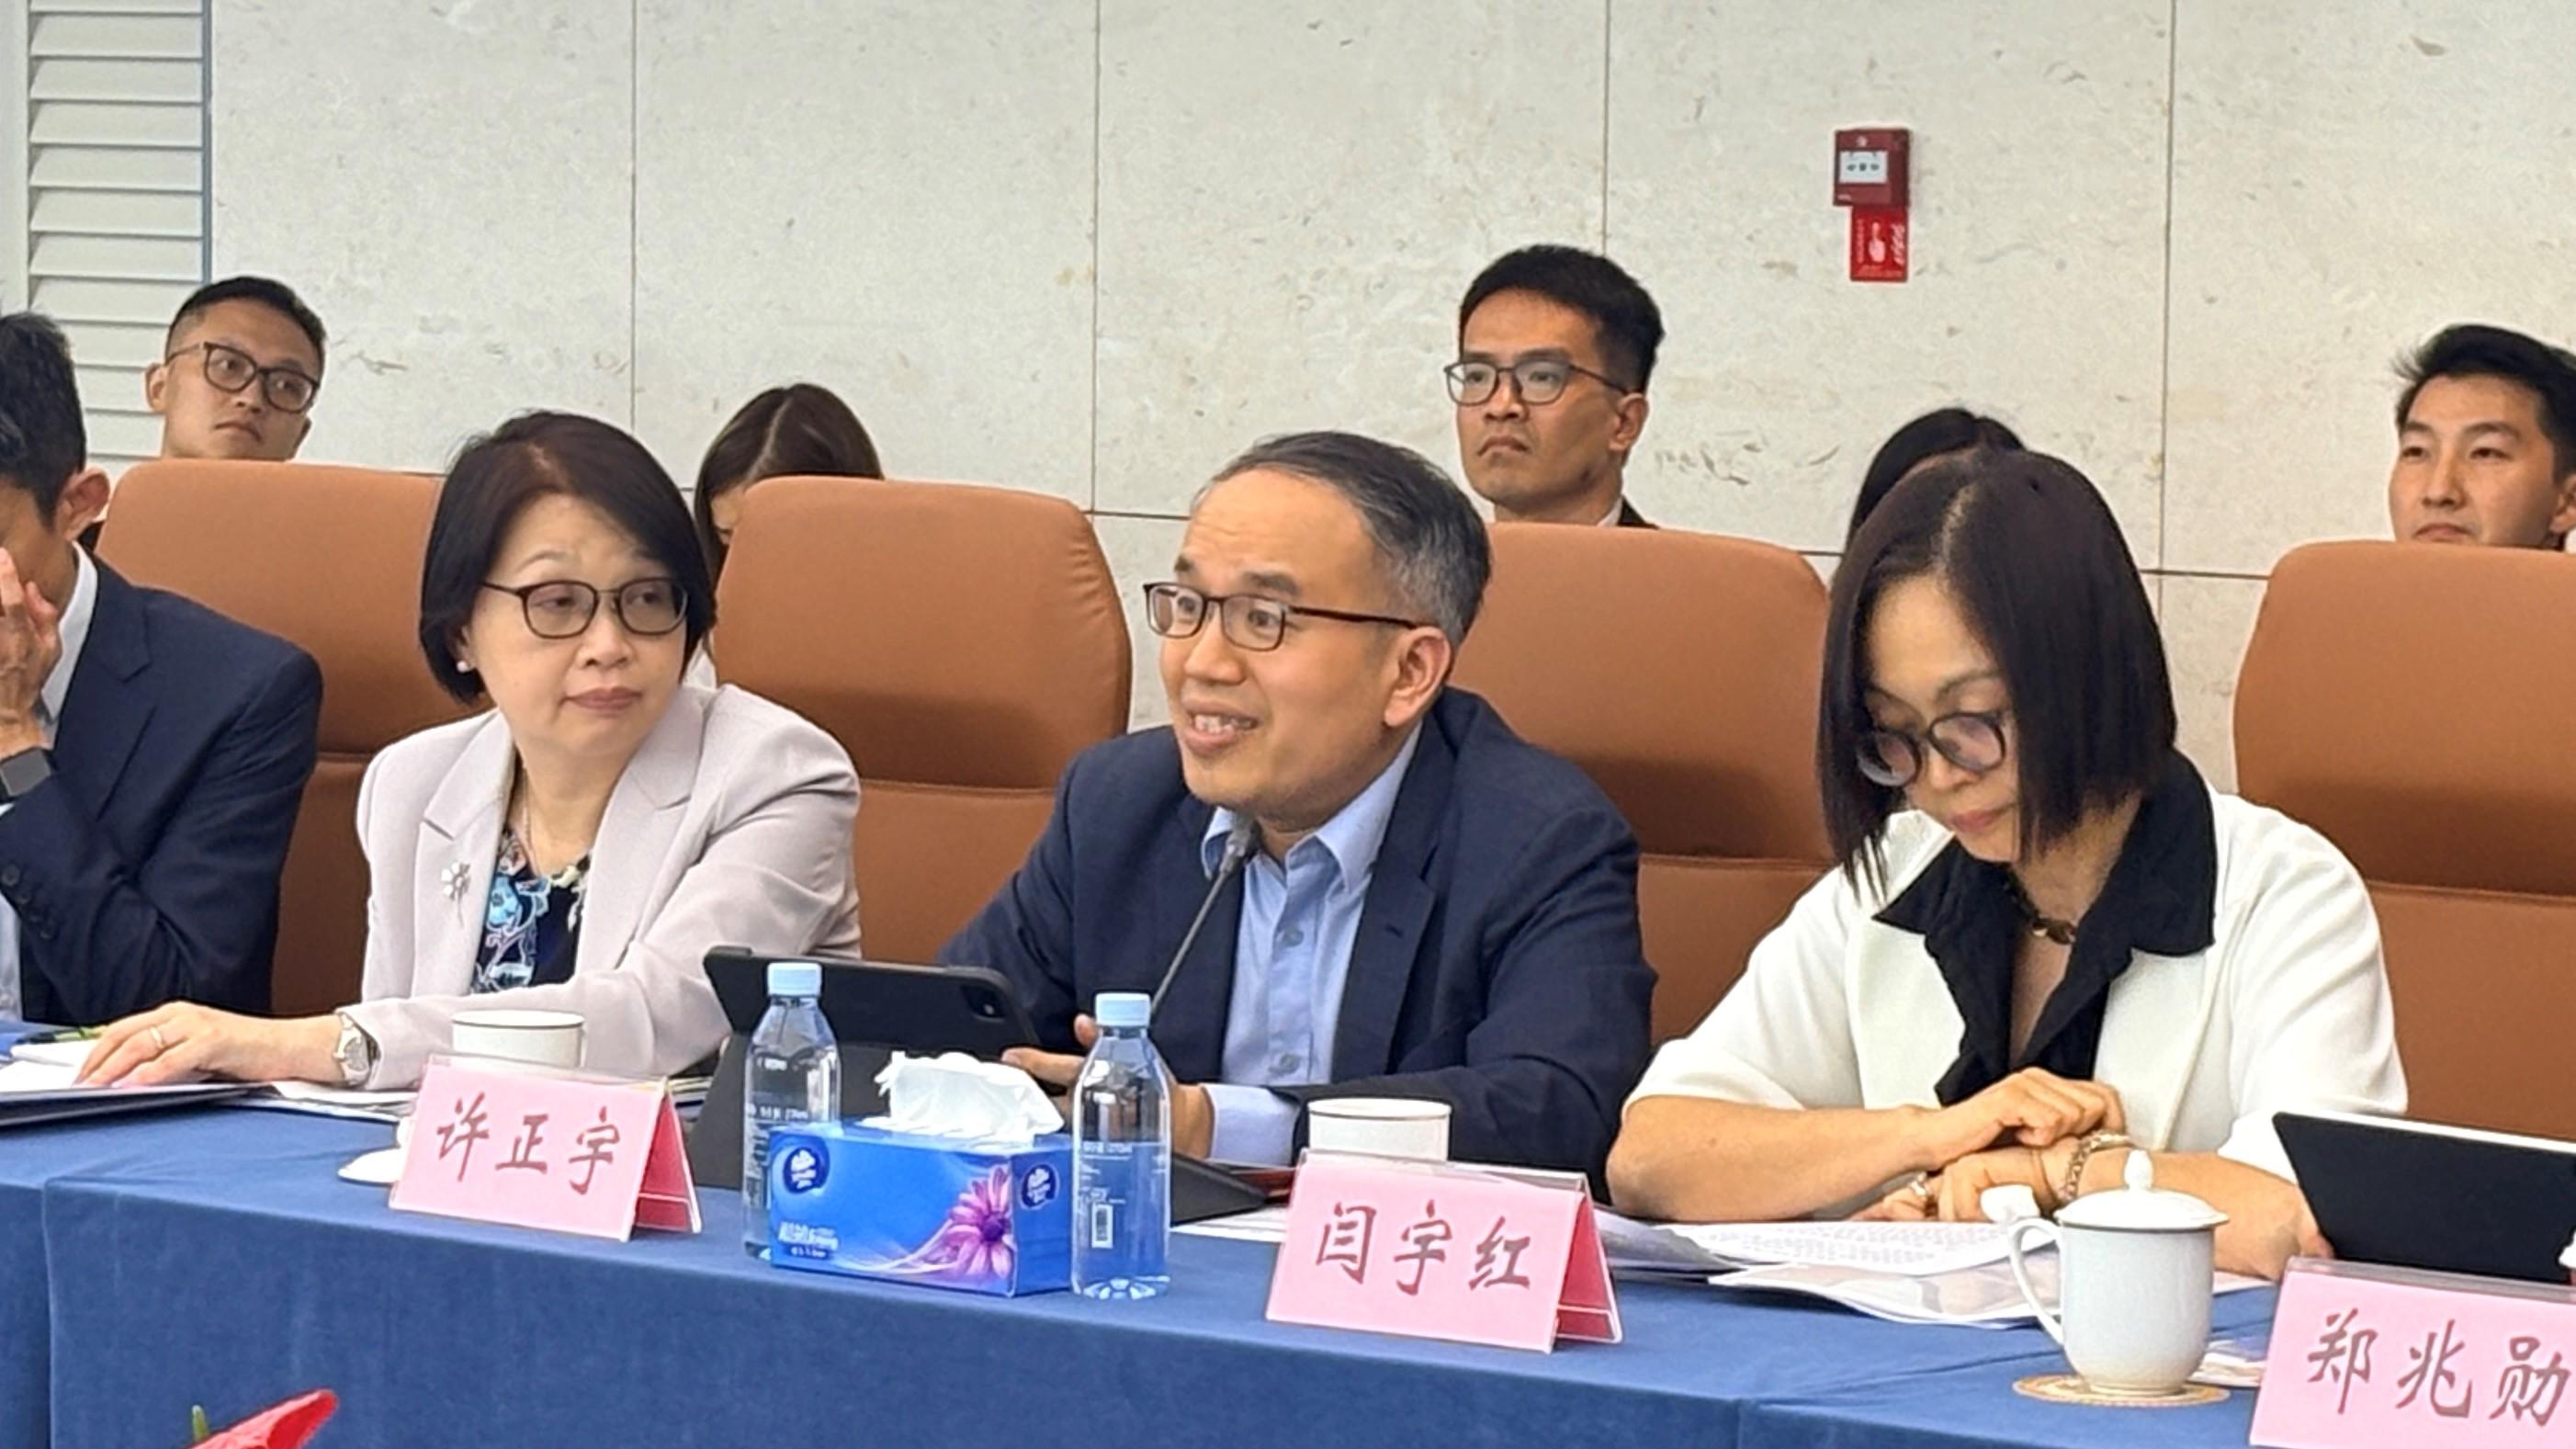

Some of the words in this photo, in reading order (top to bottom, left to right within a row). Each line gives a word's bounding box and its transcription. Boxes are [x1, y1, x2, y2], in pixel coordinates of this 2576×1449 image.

[436, 1091, 621, 1195] 许正宇
[1315, 1199, 1531, 1296] 闫宇红
[2306, 1307, 2571, 1427] 郑兆勋
